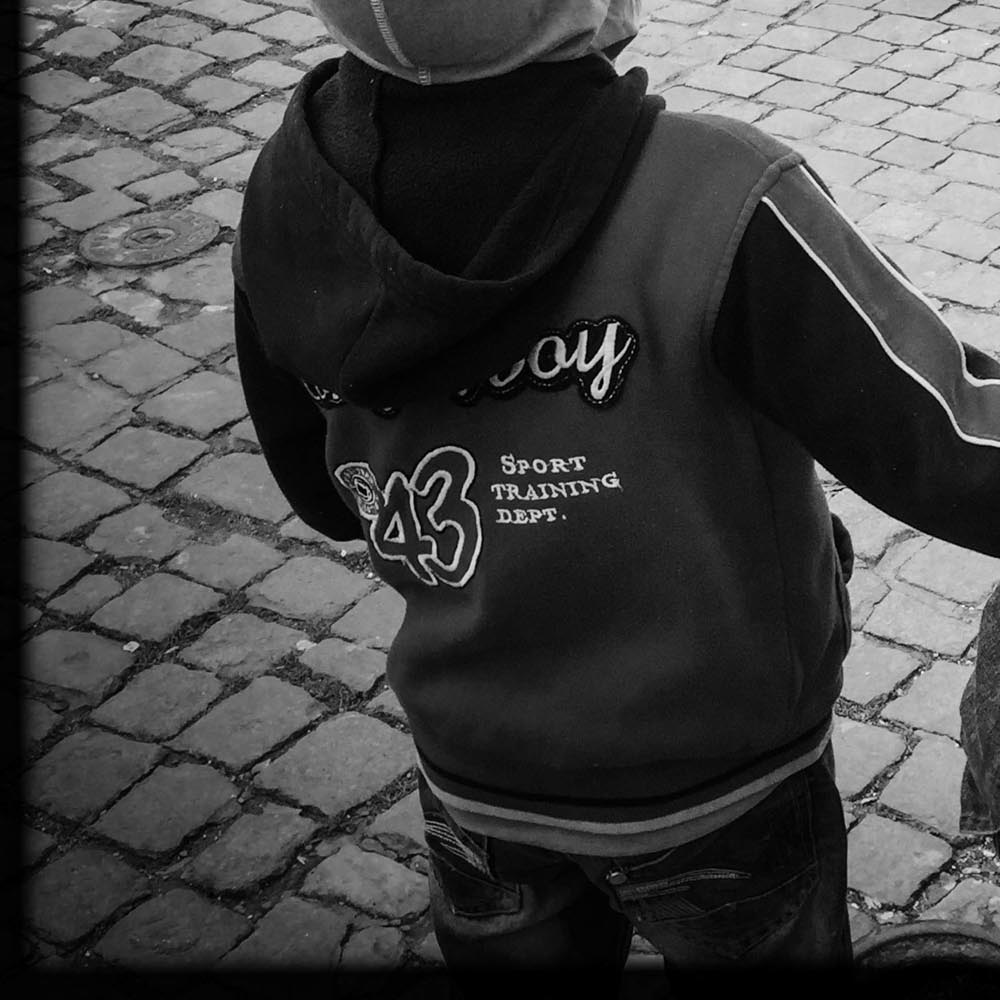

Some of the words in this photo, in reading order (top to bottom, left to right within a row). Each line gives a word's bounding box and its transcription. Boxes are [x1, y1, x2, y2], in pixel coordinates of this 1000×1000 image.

[500, 453, 587, 475] SPORT
[491, 472, 623, 500] TRAINING
[369, 446, 482, 588] 43
[496, 508, 567, 525] DEPT.
